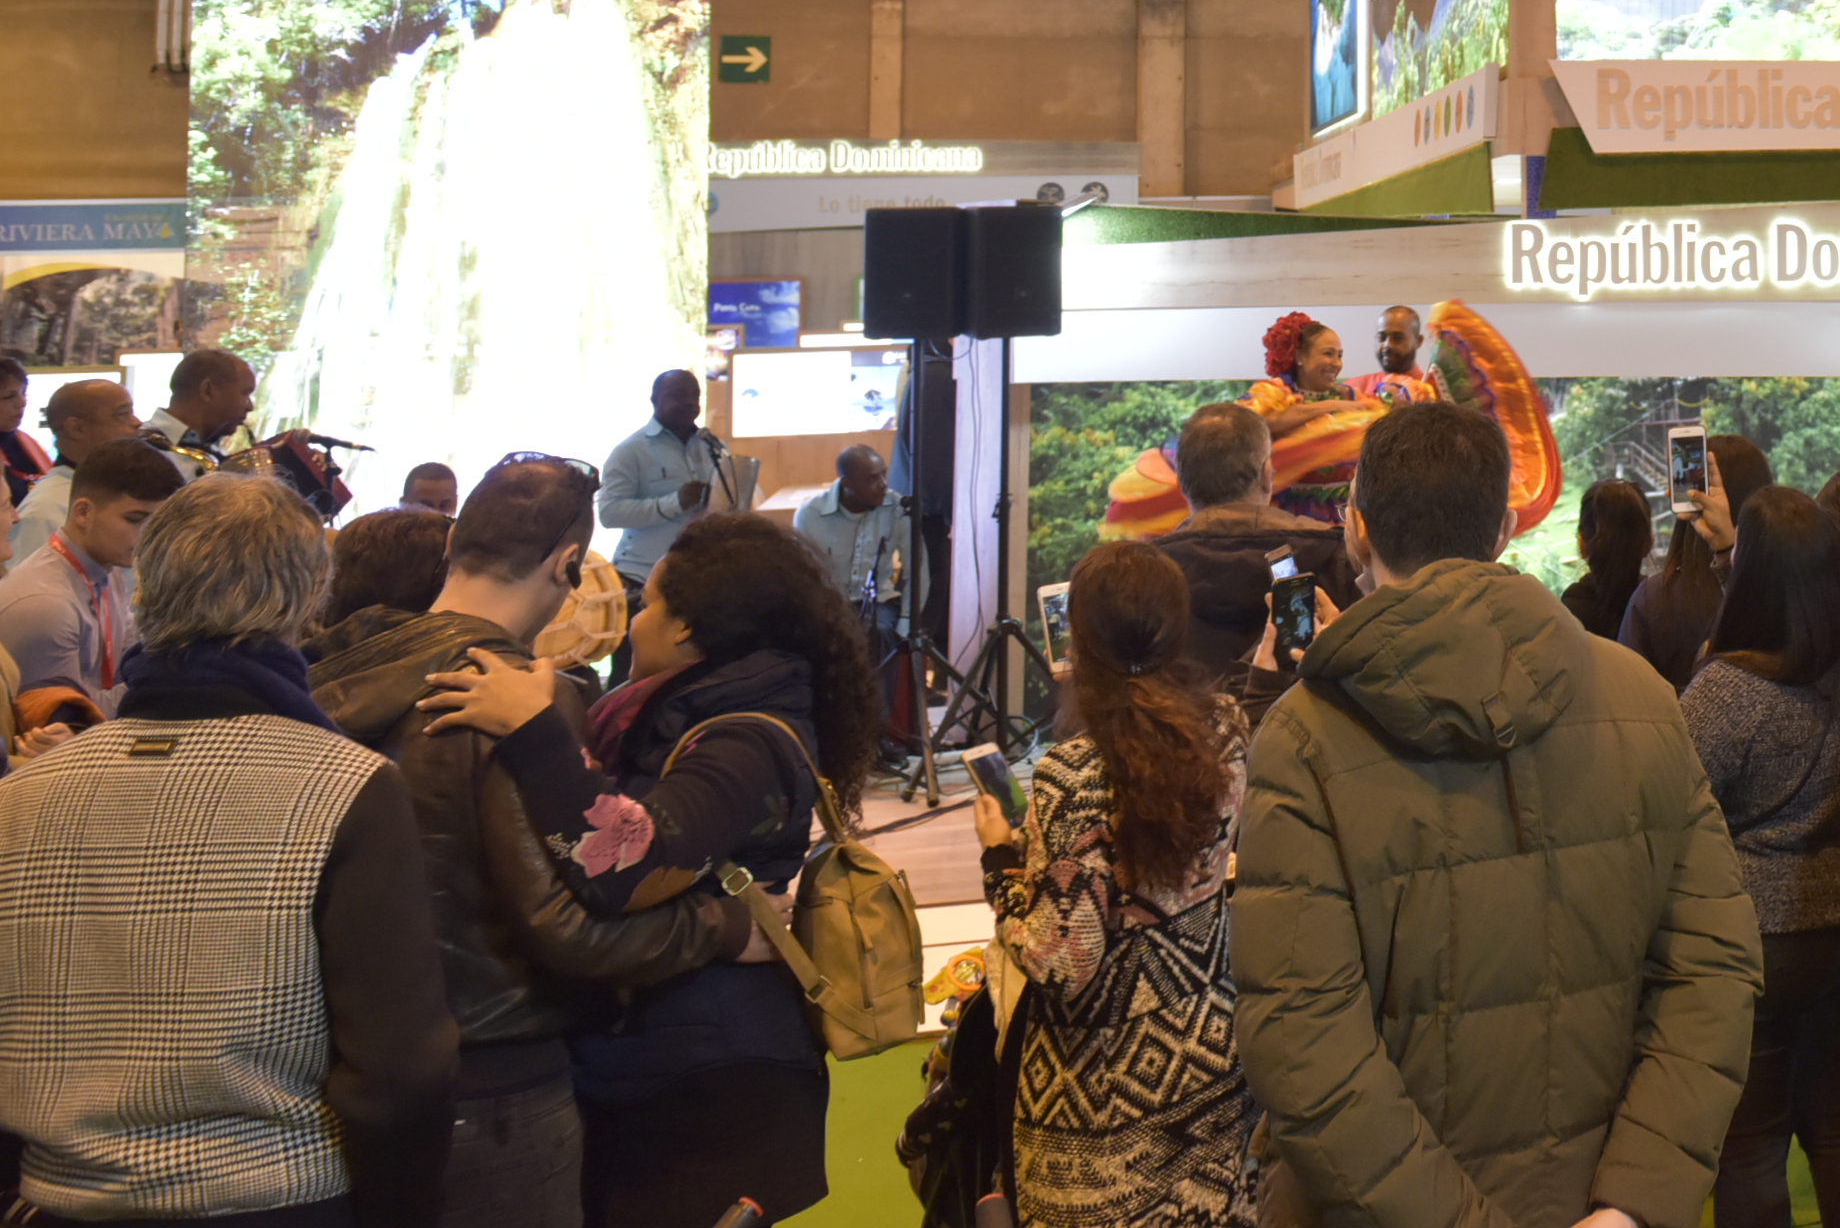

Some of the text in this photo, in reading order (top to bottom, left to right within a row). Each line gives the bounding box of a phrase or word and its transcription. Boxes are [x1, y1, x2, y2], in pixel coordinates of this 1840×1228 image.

[831, 140, 983, 173] Dominicana
[819, 196, 841, 214] Lo
[1508, 221, 1761, 296] República
